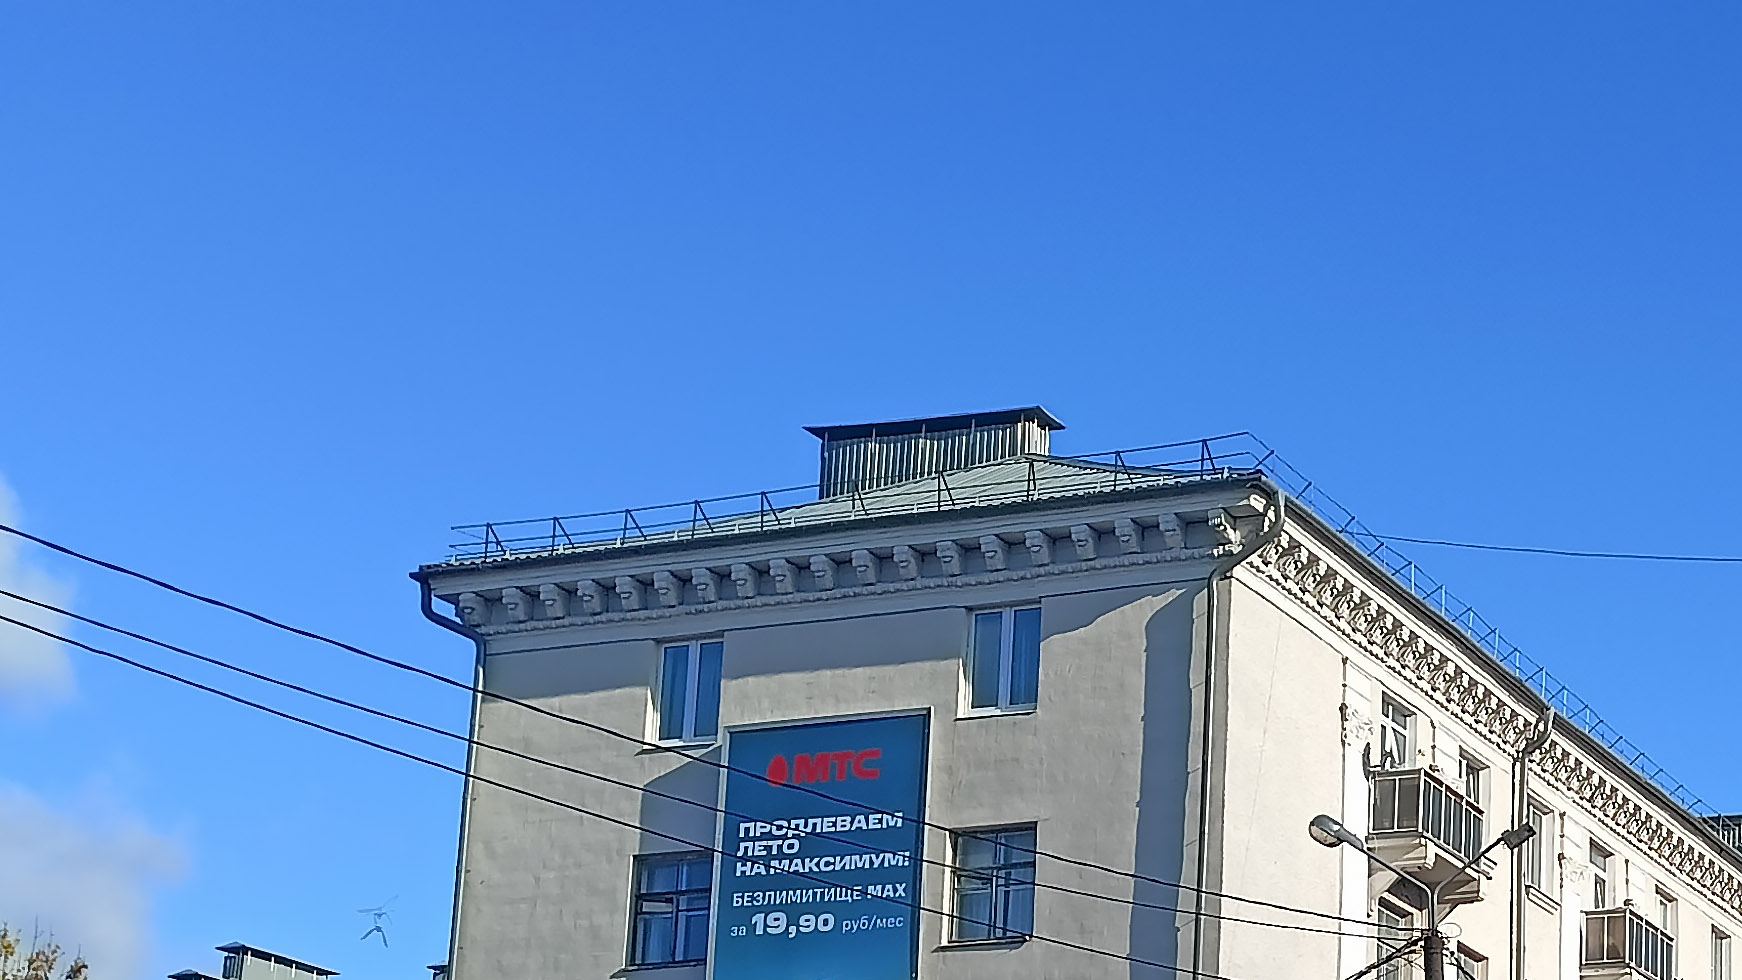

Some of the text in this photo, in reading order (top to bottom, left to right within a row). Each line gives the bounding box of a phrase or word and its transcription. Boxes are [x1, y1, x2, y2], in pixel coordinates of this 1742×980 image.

[794, 749, 882, 784] МТС
[739, 812, 903, 837] ПРОДЛЕВАЕМ
[737, 839, 799, 857] ЛЕТО
[736, 851, 910, 877] НА МАКСИМУМ!
[733, 886, 862, 906] БЕЗЛИМИТИЩЕ
[730, 911, 904, 938] за 19,90 руб/мес
